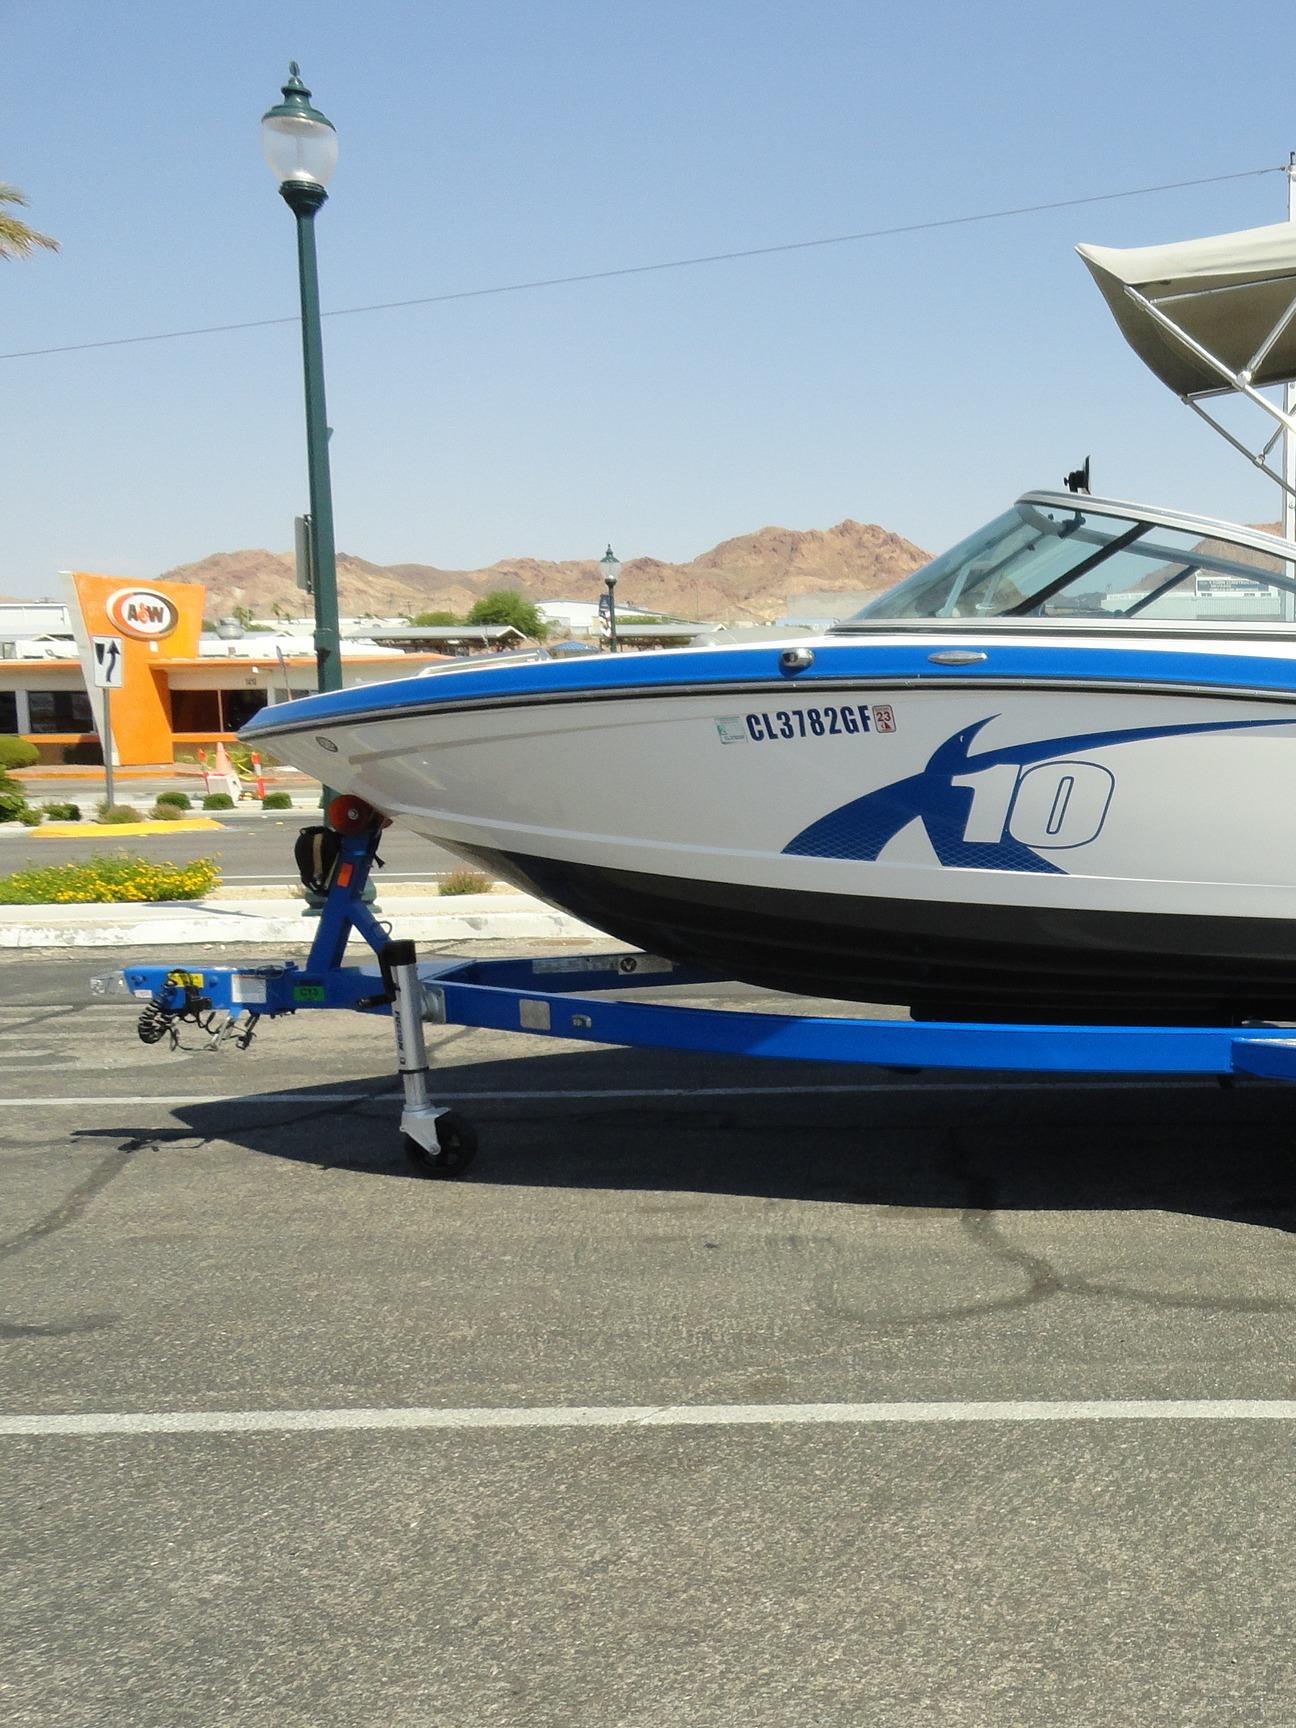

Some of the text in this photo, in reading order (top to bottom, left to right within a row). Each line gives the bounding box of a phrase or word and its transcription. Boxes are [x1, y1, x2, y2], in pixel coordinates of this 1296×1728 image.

[127, 603, 164, 624] A&W
[746, 704, 871, 742] CL3782GF
[876, 711, 892, 723] 23
